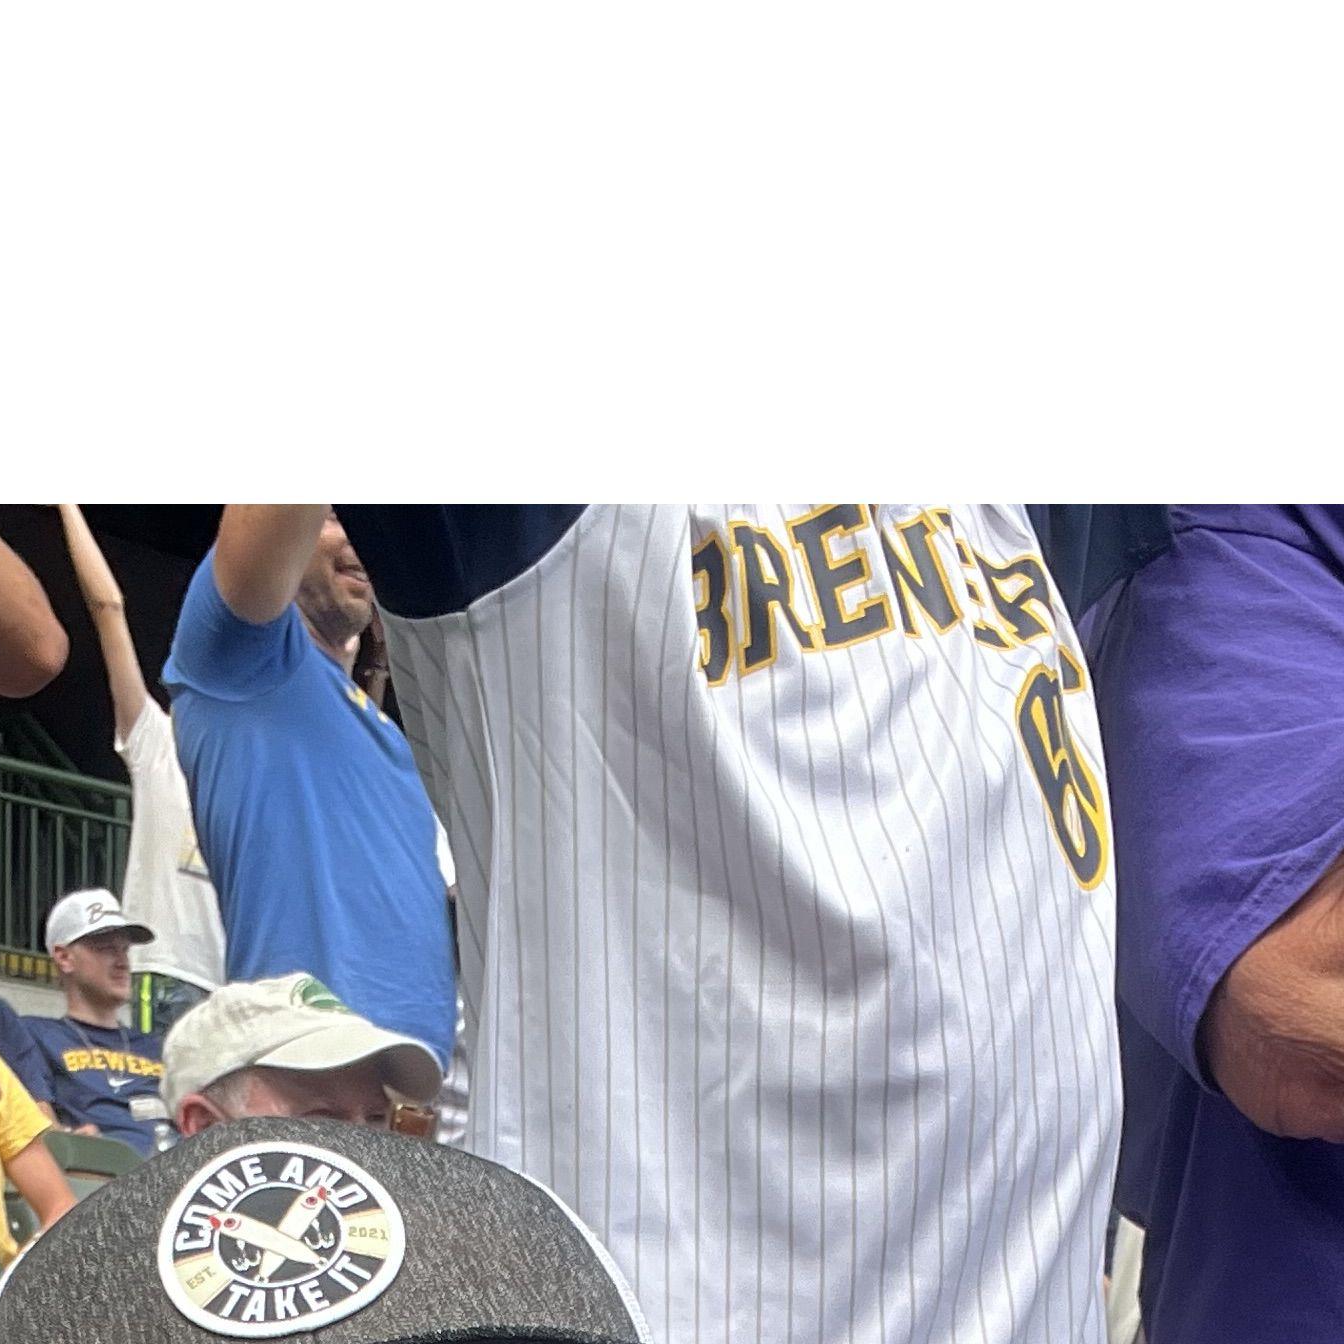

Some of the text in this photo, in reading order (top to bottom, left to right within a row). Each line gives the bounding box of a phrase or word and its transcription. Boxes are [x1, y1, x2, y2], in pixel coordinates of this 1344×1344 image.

[1014, 662, 1106, 891] 6
[174, 1156, 368, 1252] COME AND
[348, 1226, 389, 1242] 2021
[218, 1255, 373, 1322] TAKE IT
